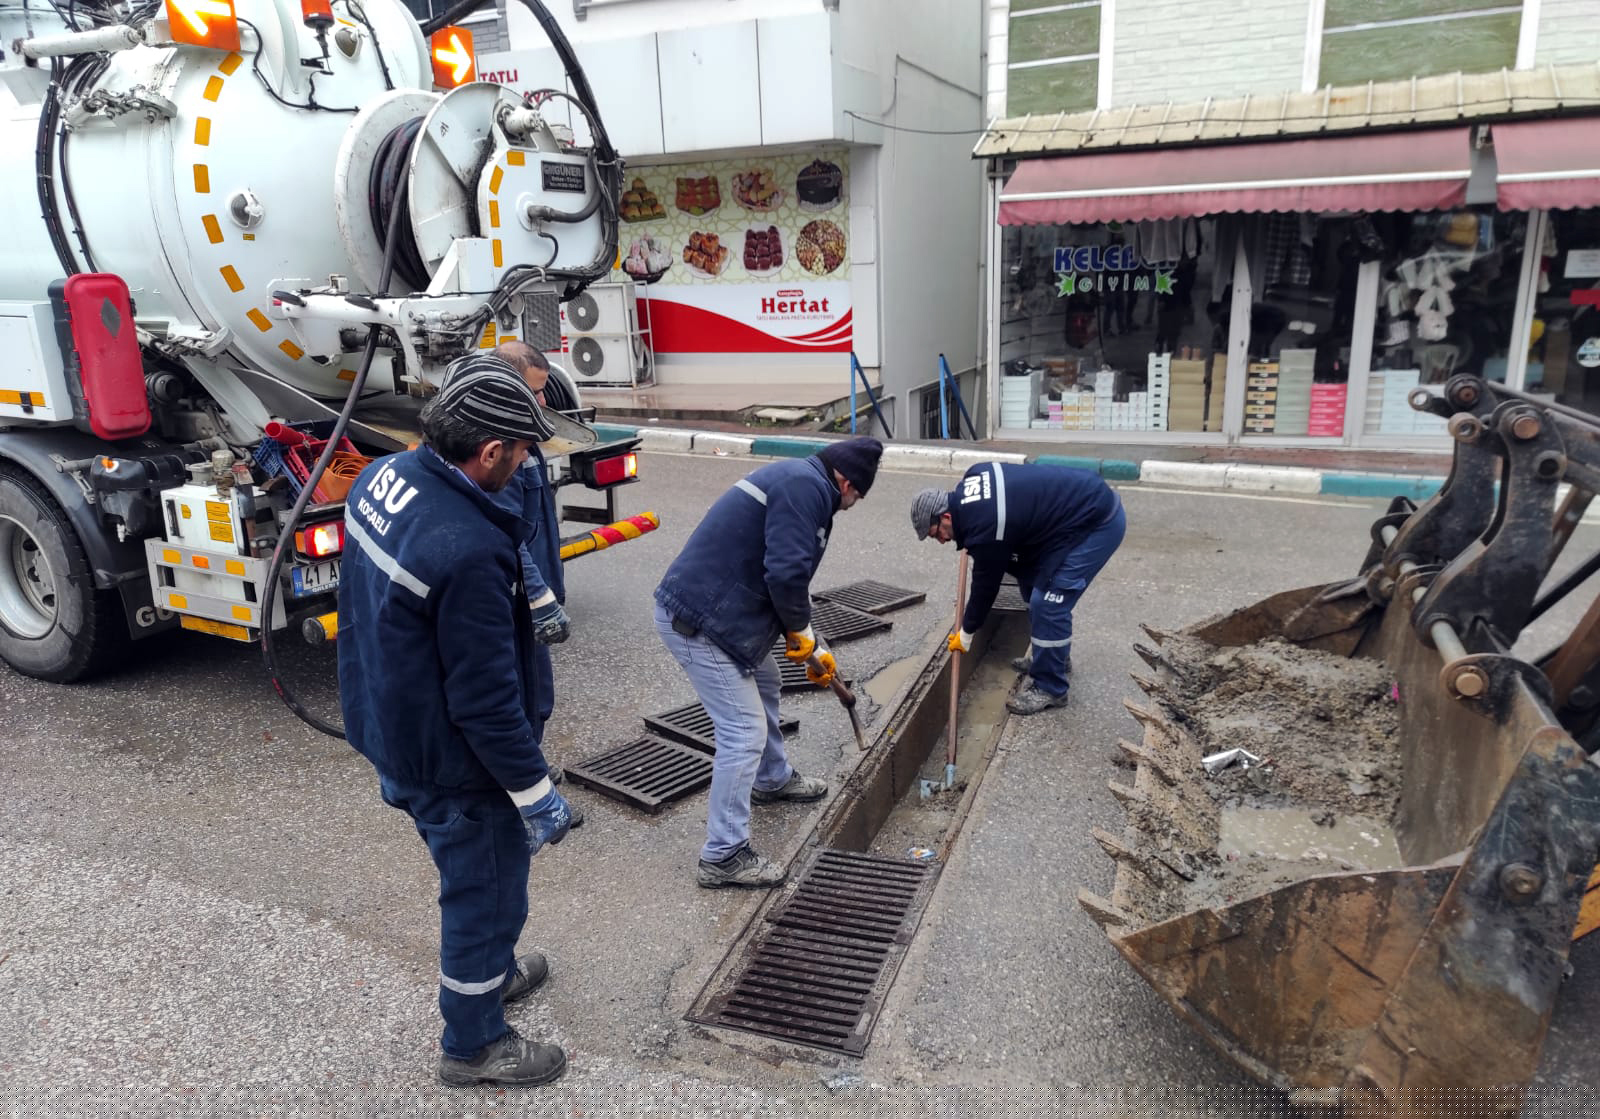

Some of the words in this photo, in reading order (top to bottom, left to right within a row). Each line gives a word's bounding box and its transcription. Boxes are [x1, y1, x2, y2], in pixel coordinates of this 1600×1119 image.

[480, 69, 518, 83] TATLI
[761, 297, 829, 313] Hertat
[367, 457, 419, 514] İSU
[357, 496, 392, 536] KOCAELİ
[305, 565, 320, 586] 41
